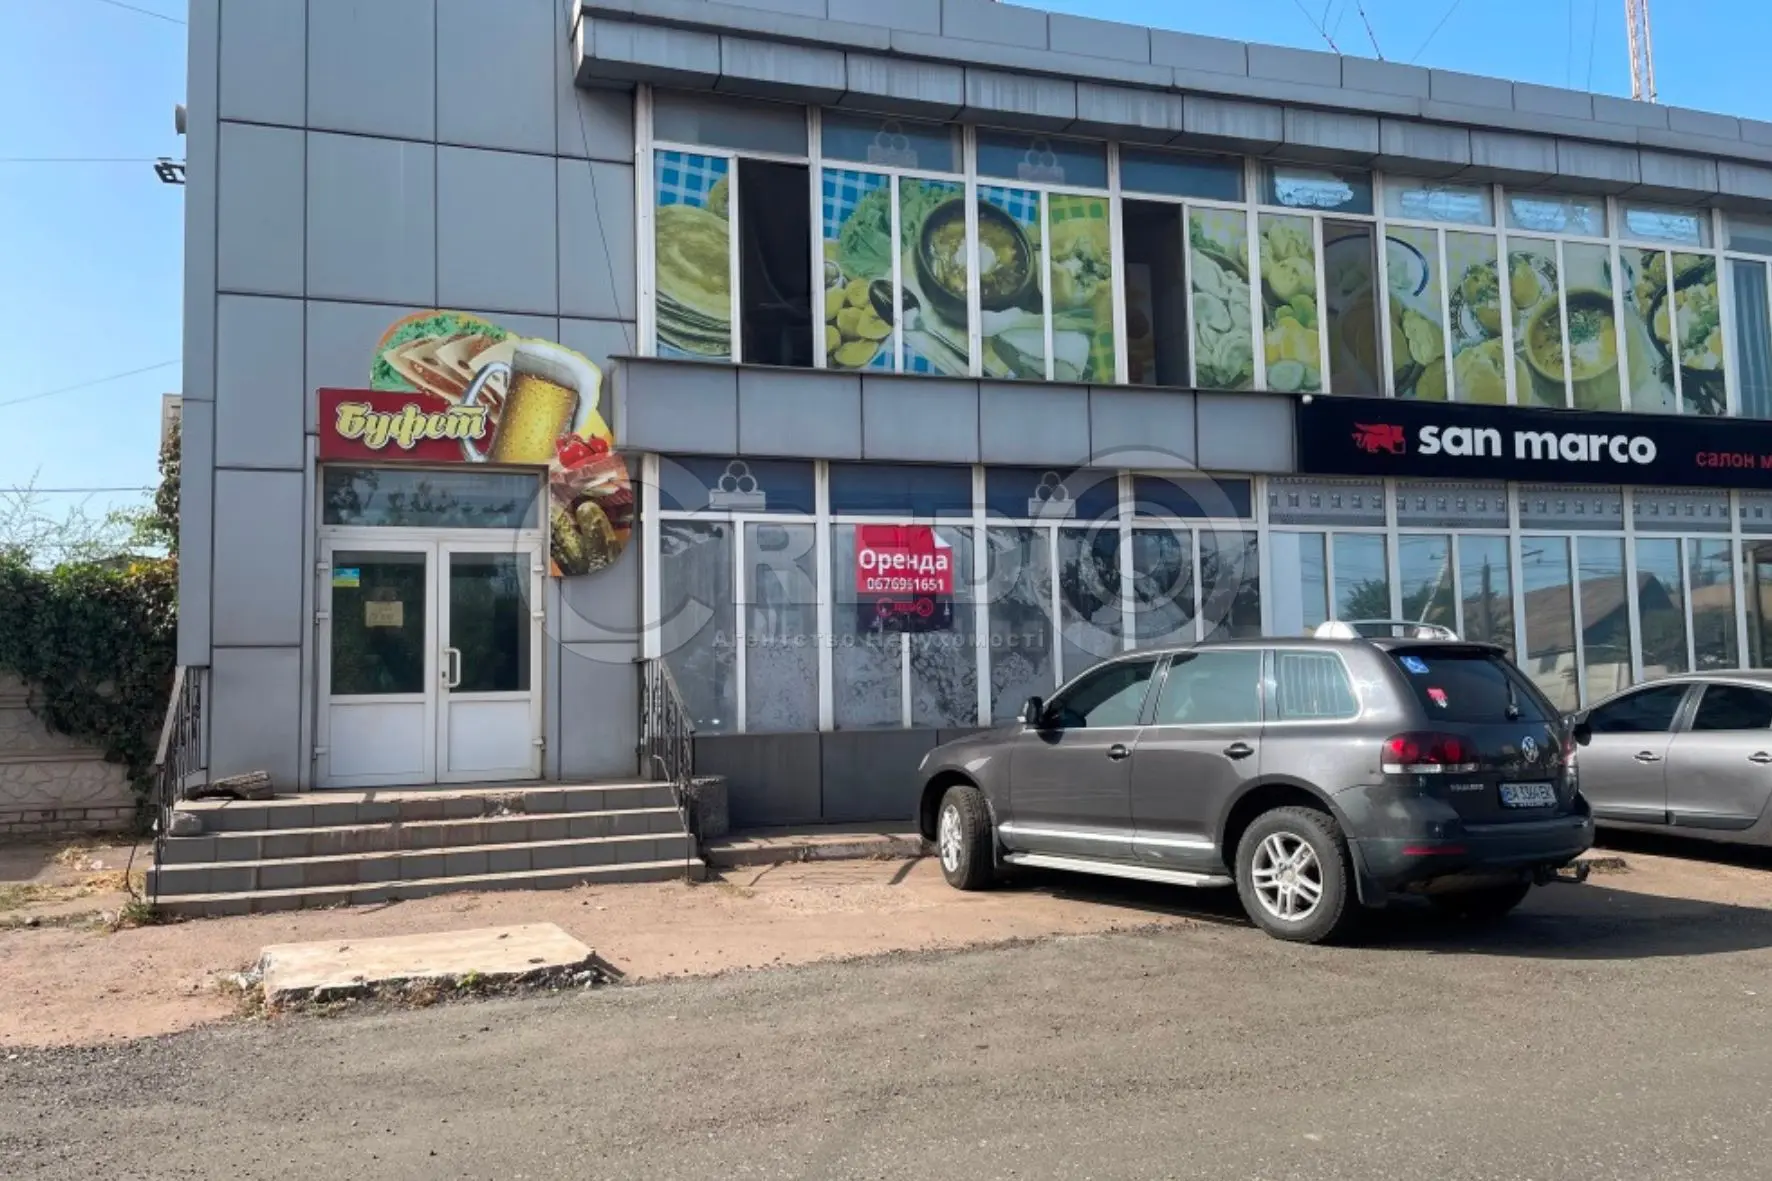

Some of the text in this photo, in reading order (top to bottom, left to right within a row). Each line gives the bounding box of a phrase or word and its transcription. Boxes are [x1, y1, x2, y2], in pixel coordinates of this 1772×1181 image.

[336, 402, 488, 448] Буфет
[1418, 425, 1657, 465] san marco
[1696, 451, 1755, 469] салон
[859, 548, 949, 576] Оренда
